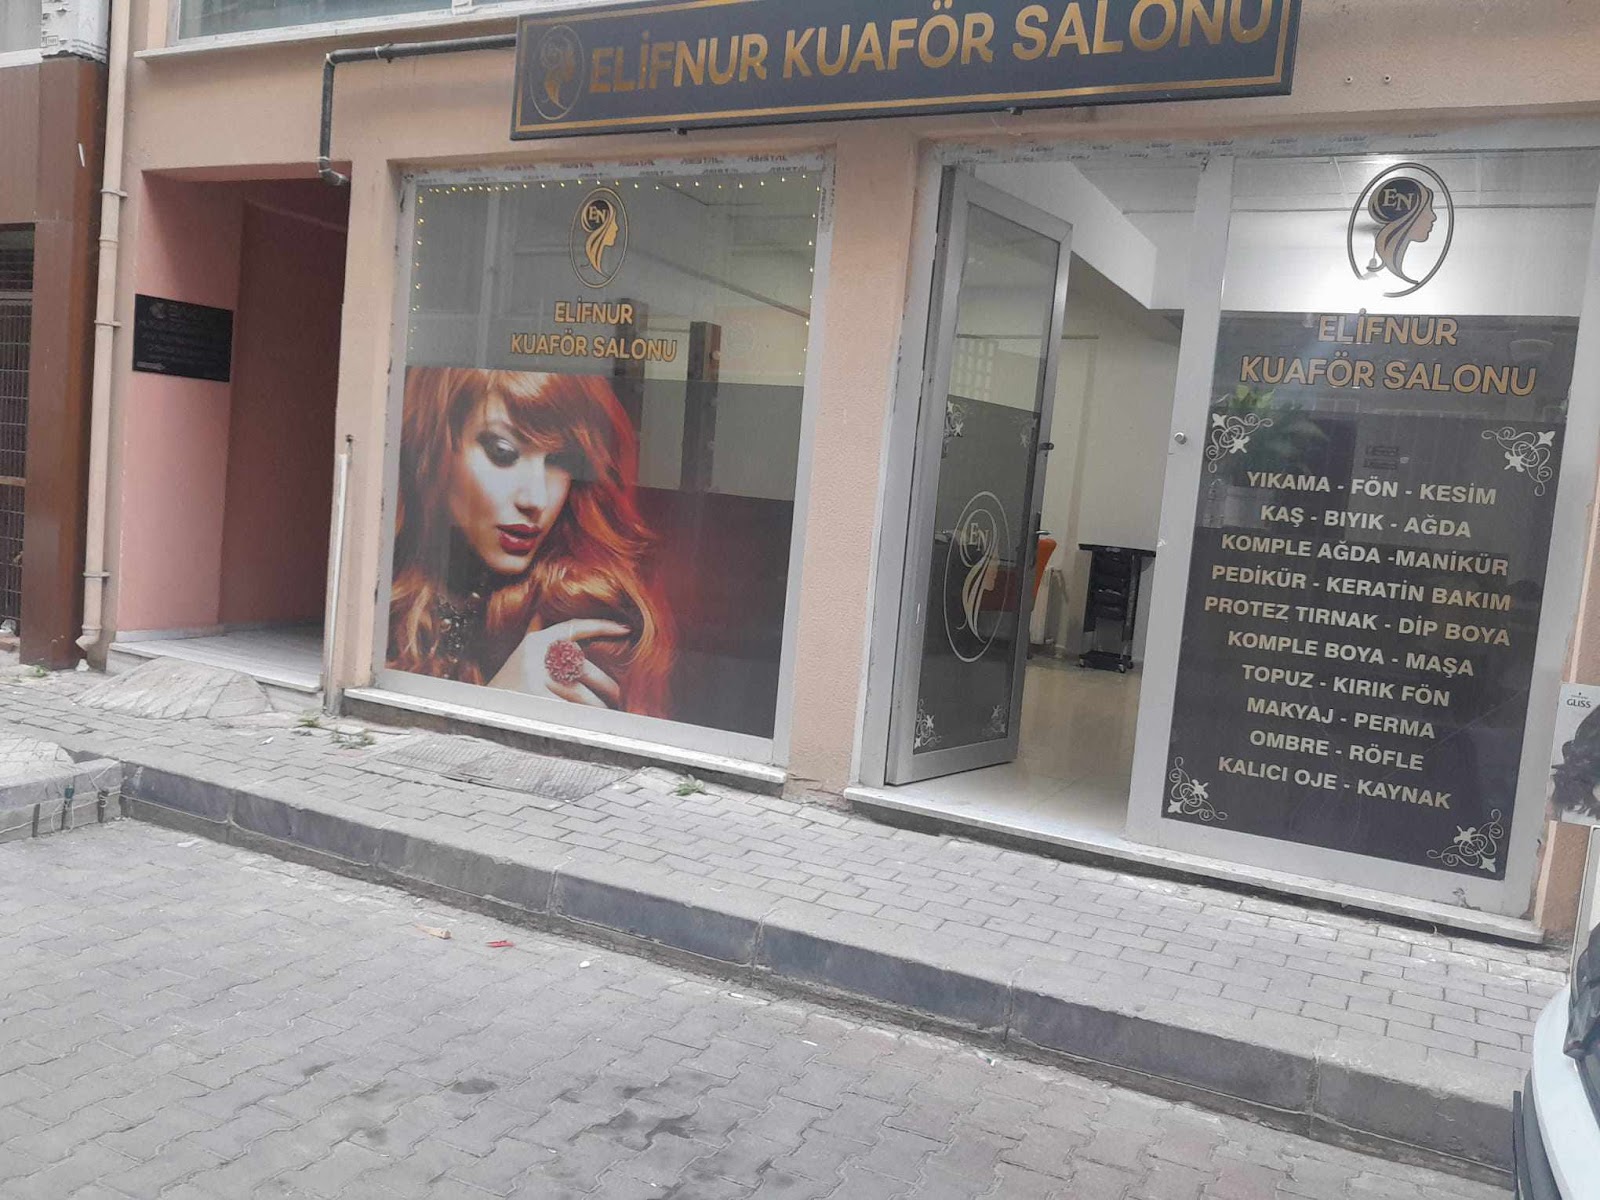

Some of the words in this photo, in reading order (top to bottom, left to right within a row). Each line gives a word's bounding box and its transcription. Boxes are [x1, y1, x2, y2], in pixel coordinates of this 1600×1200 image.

[589, 31, 768, 93] ELİFNUR
[782, 0, 995, 79] KUAFÖR
[1012, 0, 1273, 61] SALONU
[554, 297, 634, 325] ELİFNUR
[1317, 308, 1458, 346] ELİFNUR
[511, 329, 588, 356] KUAFÖR
[593, 336, 677, 362] SALONU
[1240, 350, 1375, 389] KUAFÖR
[1382, 361, 1536, 396] SALONU
[1247, 471, 1330, 493] YIKAMA
[1351, 475, 1398, 498] FÖN
[1420, 483, 1496, 505] KESİM
[1260, 505, 1304, 527] KAŞ
[1324, 510, 1384, 531] BIYIK
[1404, 513, 1471, 538] AĞDA
[1221, 534, 1312, 557] KOMPLE
[1317, 540, 1381, 564] AĞDA
[1211, 564, 1307, 589] PEDİKÜR
[1326, 576, 1424, 602] KERATİN
[1432, 588, 1511, 612] BAKIM
[1204, 596, 1289, 621] PROTEZ
[1295, 606, 1379, 631] TIRNAK
[1399, 615, 1438, 638] DİP
[1444, 623, 1511, 646] BOYA
[1228, 630, 1317, 657] KOMPLE
[1324, 642, 1384, 665] BOYA
[1405, 652, 1474, 678] MAŞA
[1241, 664, 1313, 689] TOPUZ
[1333, 676, 1395, 700] KIRIK
[1401, 684, 1450, 707] FÖN
[1247, 697, 1334, 724] MAKYAJ
[1353, 712, 1436, 739] PERMA
[1250, 730, 1329, 757] OMBRE
[1349, 744, 1425, 772] RÖFLE
[1218, 756, 1288, 782] KALICI
[1294, 768, 1337, 791] OJE
[1357, 779, 1451, 810] KAYNAK
